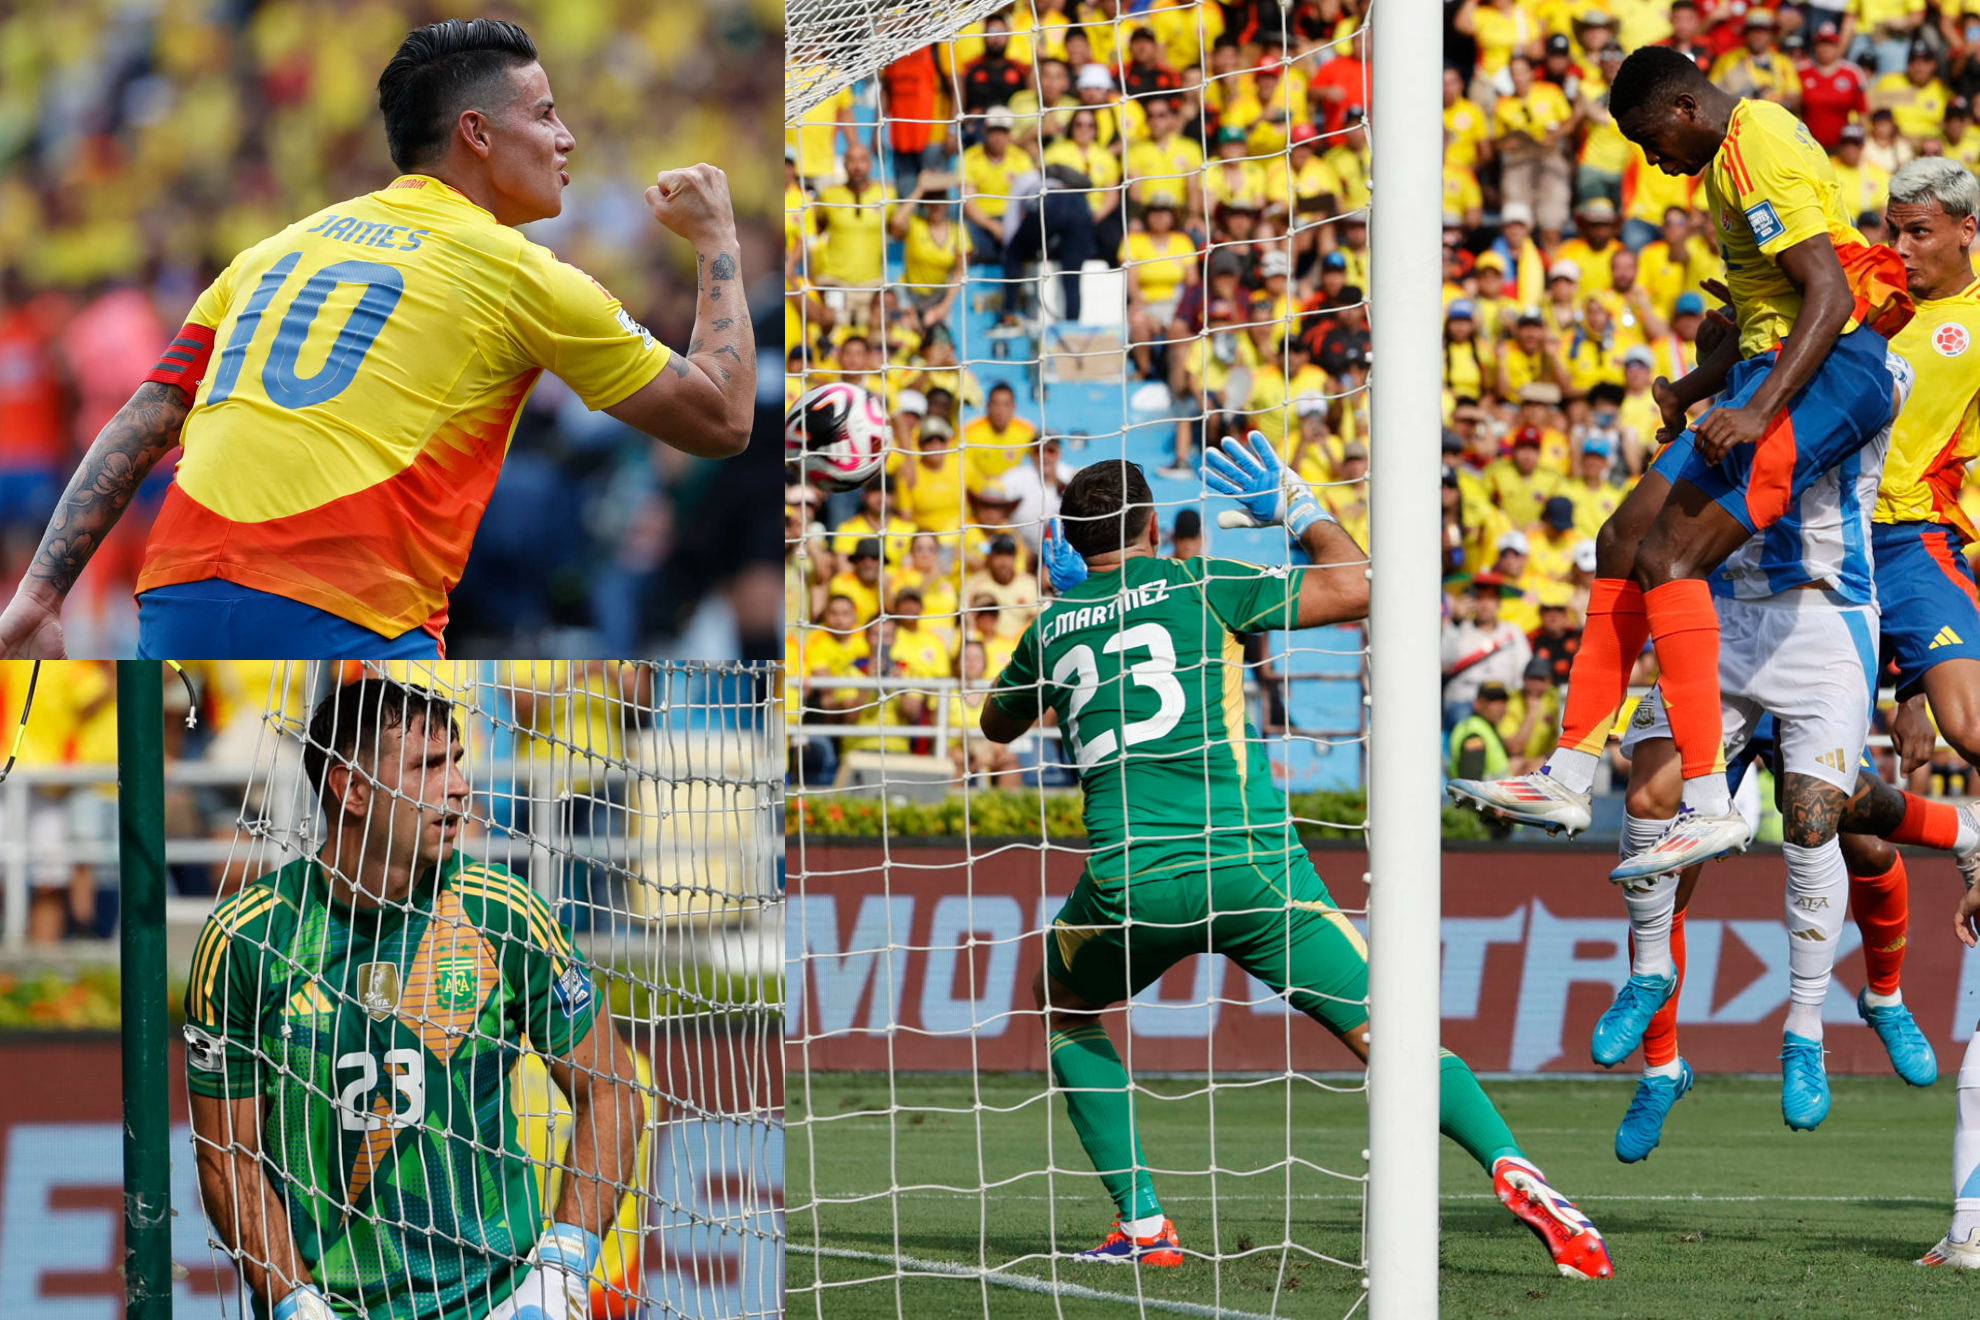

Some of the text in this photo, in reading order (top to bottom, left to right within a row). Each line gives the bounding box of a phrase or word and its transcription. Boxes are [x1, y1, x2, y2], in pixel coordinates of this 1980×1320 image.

[306, 214, 431, 251] JAMES
[206, 251, 404, 409] 10
[1052, 622, 1186, 776] 23
[337, 1048, 422, 1131] 23
